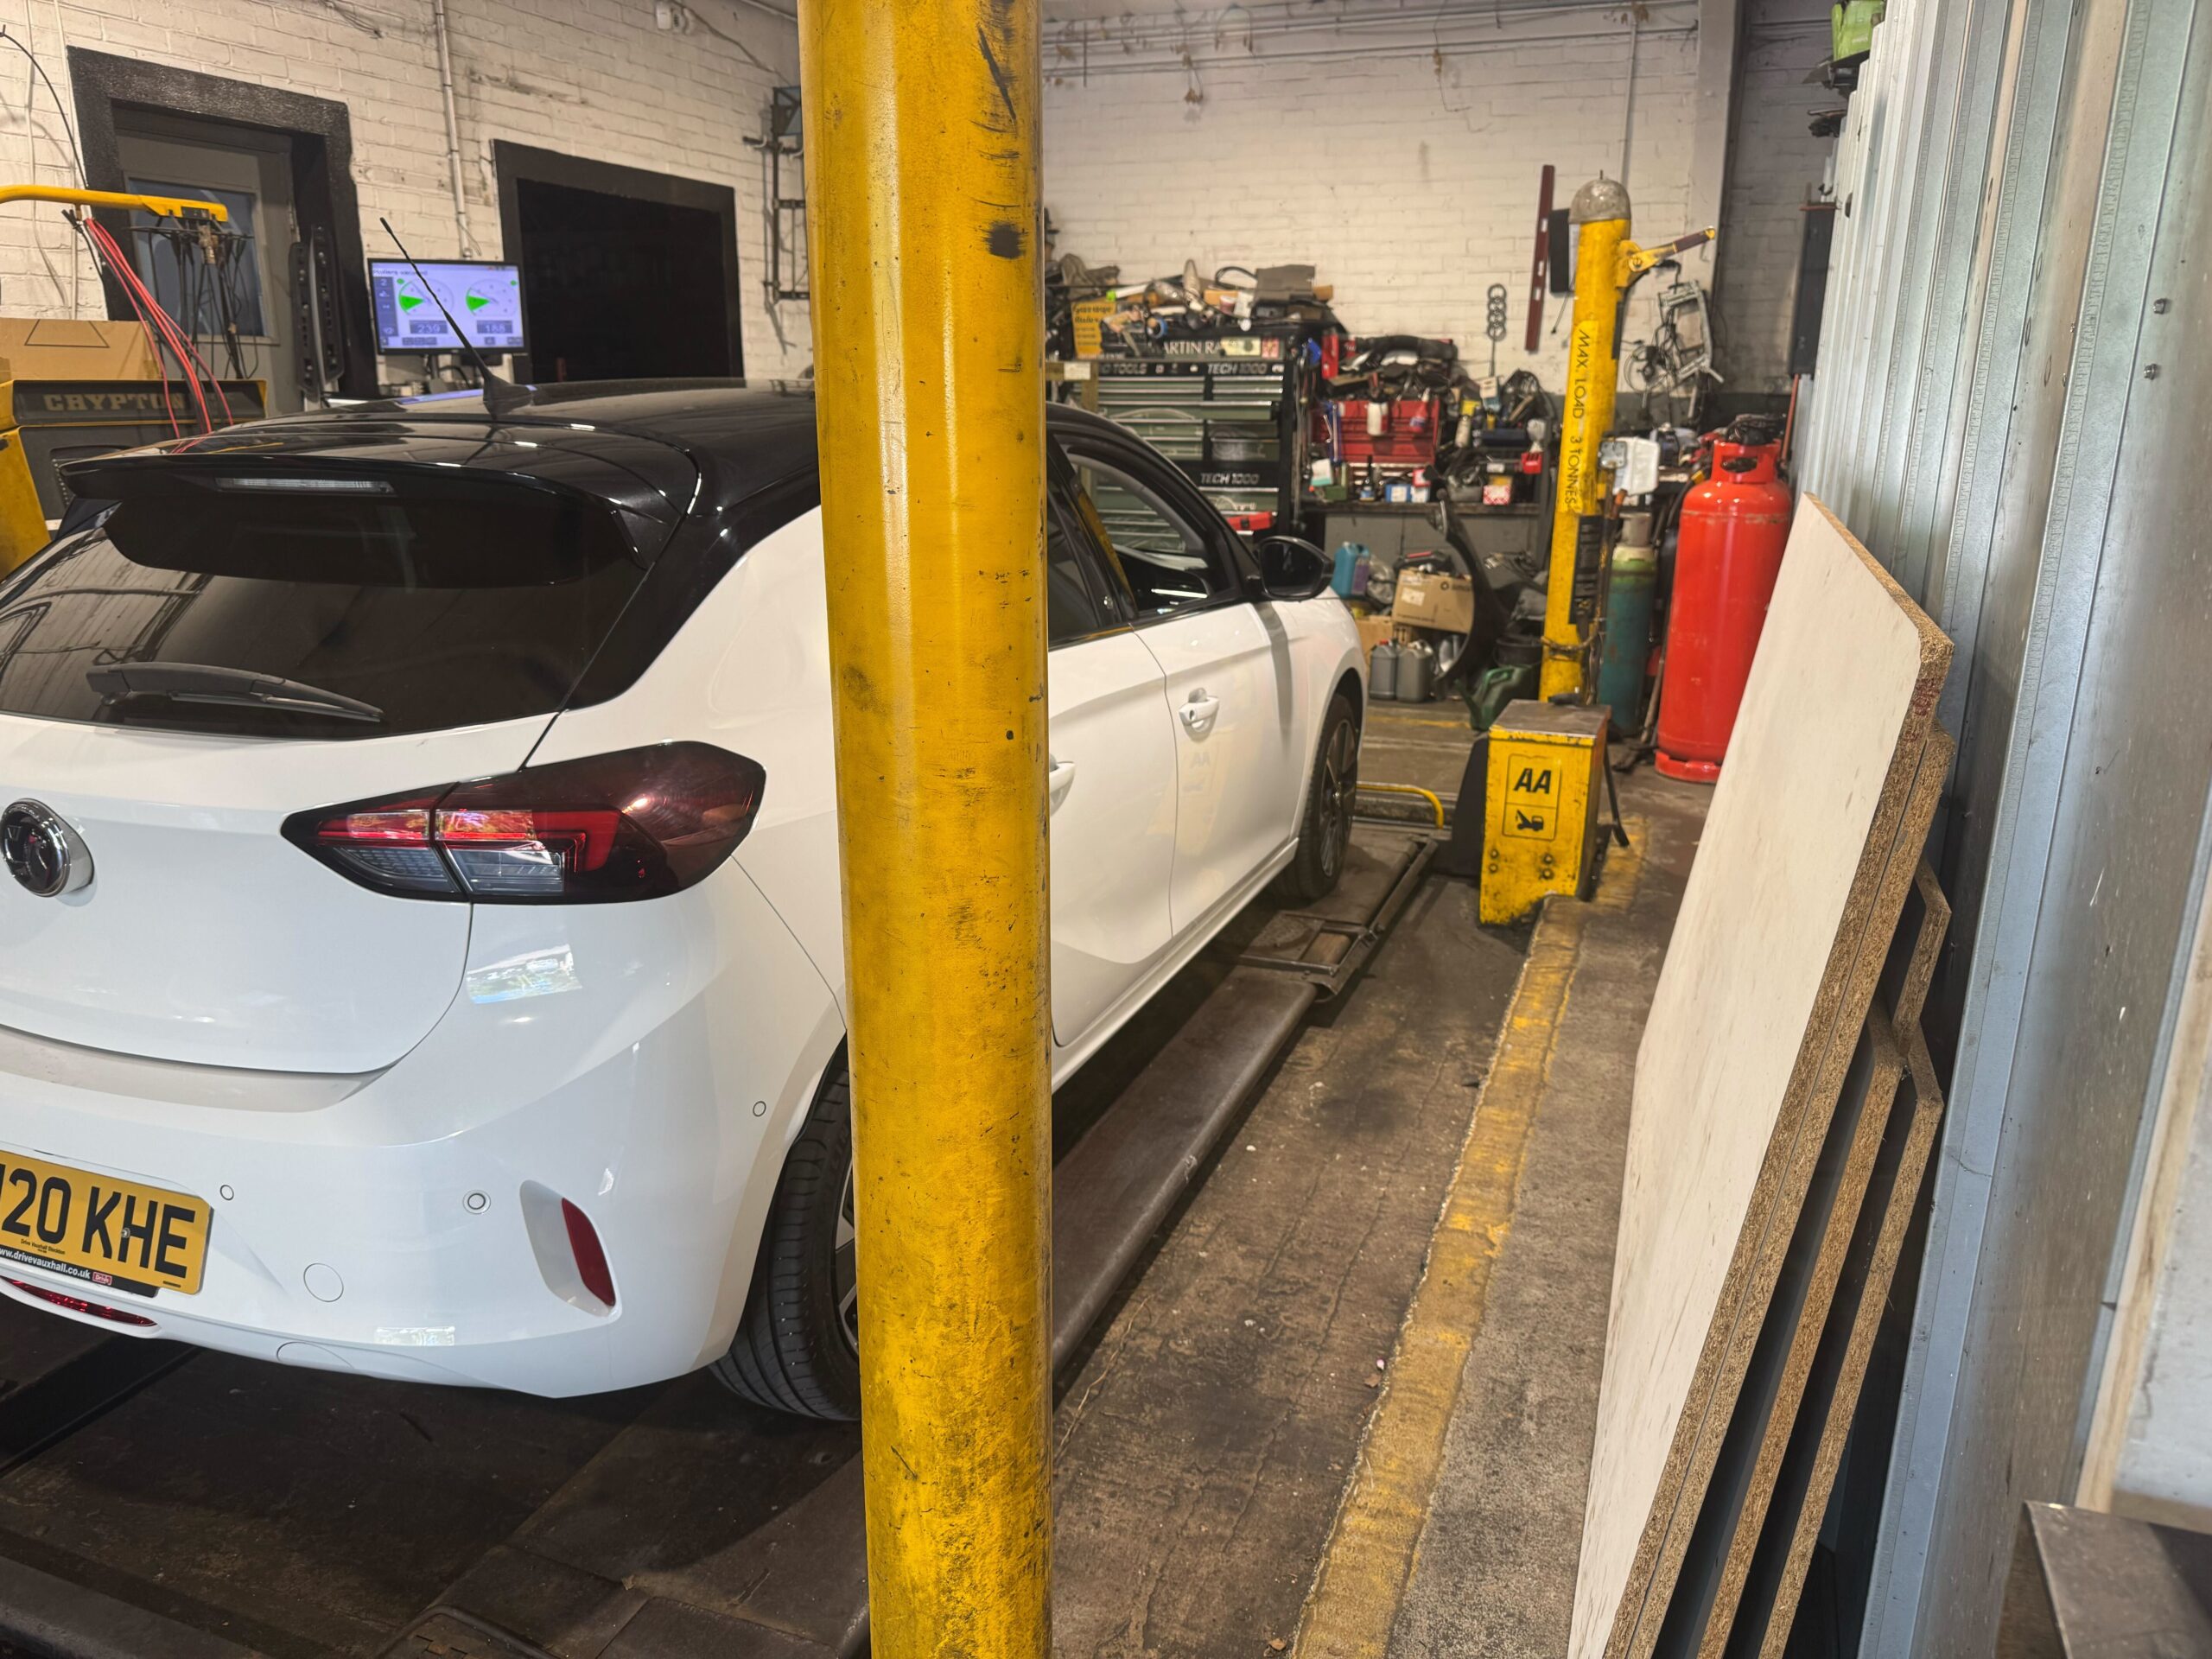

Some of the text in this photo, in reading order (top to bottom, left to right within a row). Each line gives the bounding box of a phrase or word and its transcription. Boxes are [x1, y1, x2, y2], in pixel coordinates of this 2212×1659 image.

[1207, 363, 1237, 375] TECH
[1238, 363, 1268, 374] 1000
[42, 392, 187, 412] CRYPTON
[1572, 378, 1587, 419] LOAD
[1570, 435, 1582, 444] 3
[1565, 447, 1582, 505] TONNES
[1513, 767, 1551, 794] AA
[0, 1163, 195, 1278] 20 KHE
